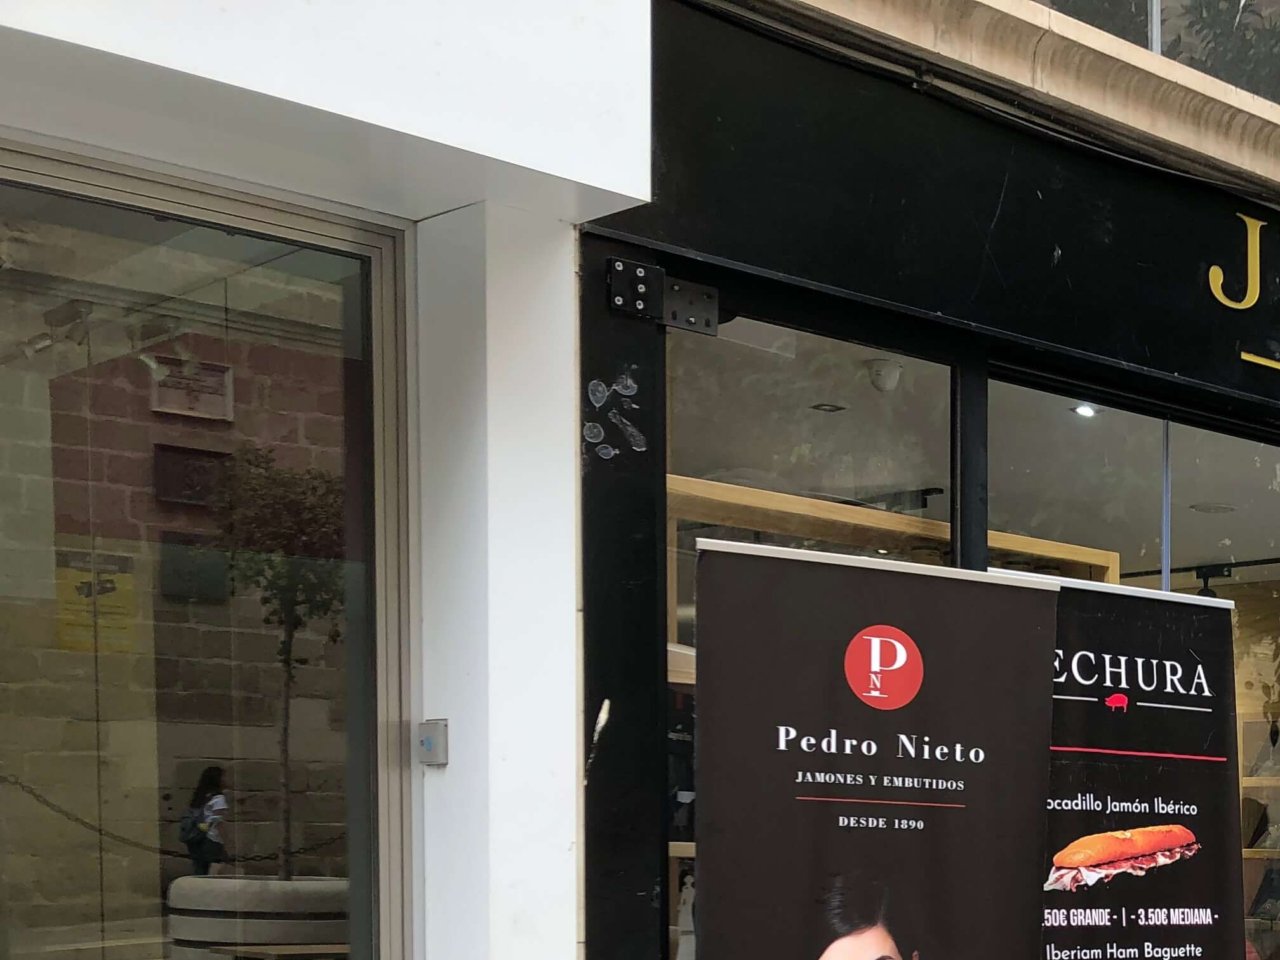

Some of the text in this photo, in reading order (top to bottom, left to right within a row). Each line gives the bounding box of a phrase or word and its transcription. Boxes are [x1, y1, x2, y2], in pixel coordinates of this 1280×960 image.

[776, 725, 985, 763] Pedro Nieto
[795, 770, 965, 791] JAMONES Y EMBUTIDOS
[1105, 796, 1149, 814] Jamón
[1154, 797, 1198, 816] Ibérico
[838, 816, 925, 830] DESDE 1890
[1069, 908, 1111, 926] GRANDE
[1137, 908, 1168, 926] 3.50€
[1170, 908, 1213, 926] MEDIANA
[1046, 943, 1102, 960] Iberiam
[1106, 943, 1139, 960] Ham
